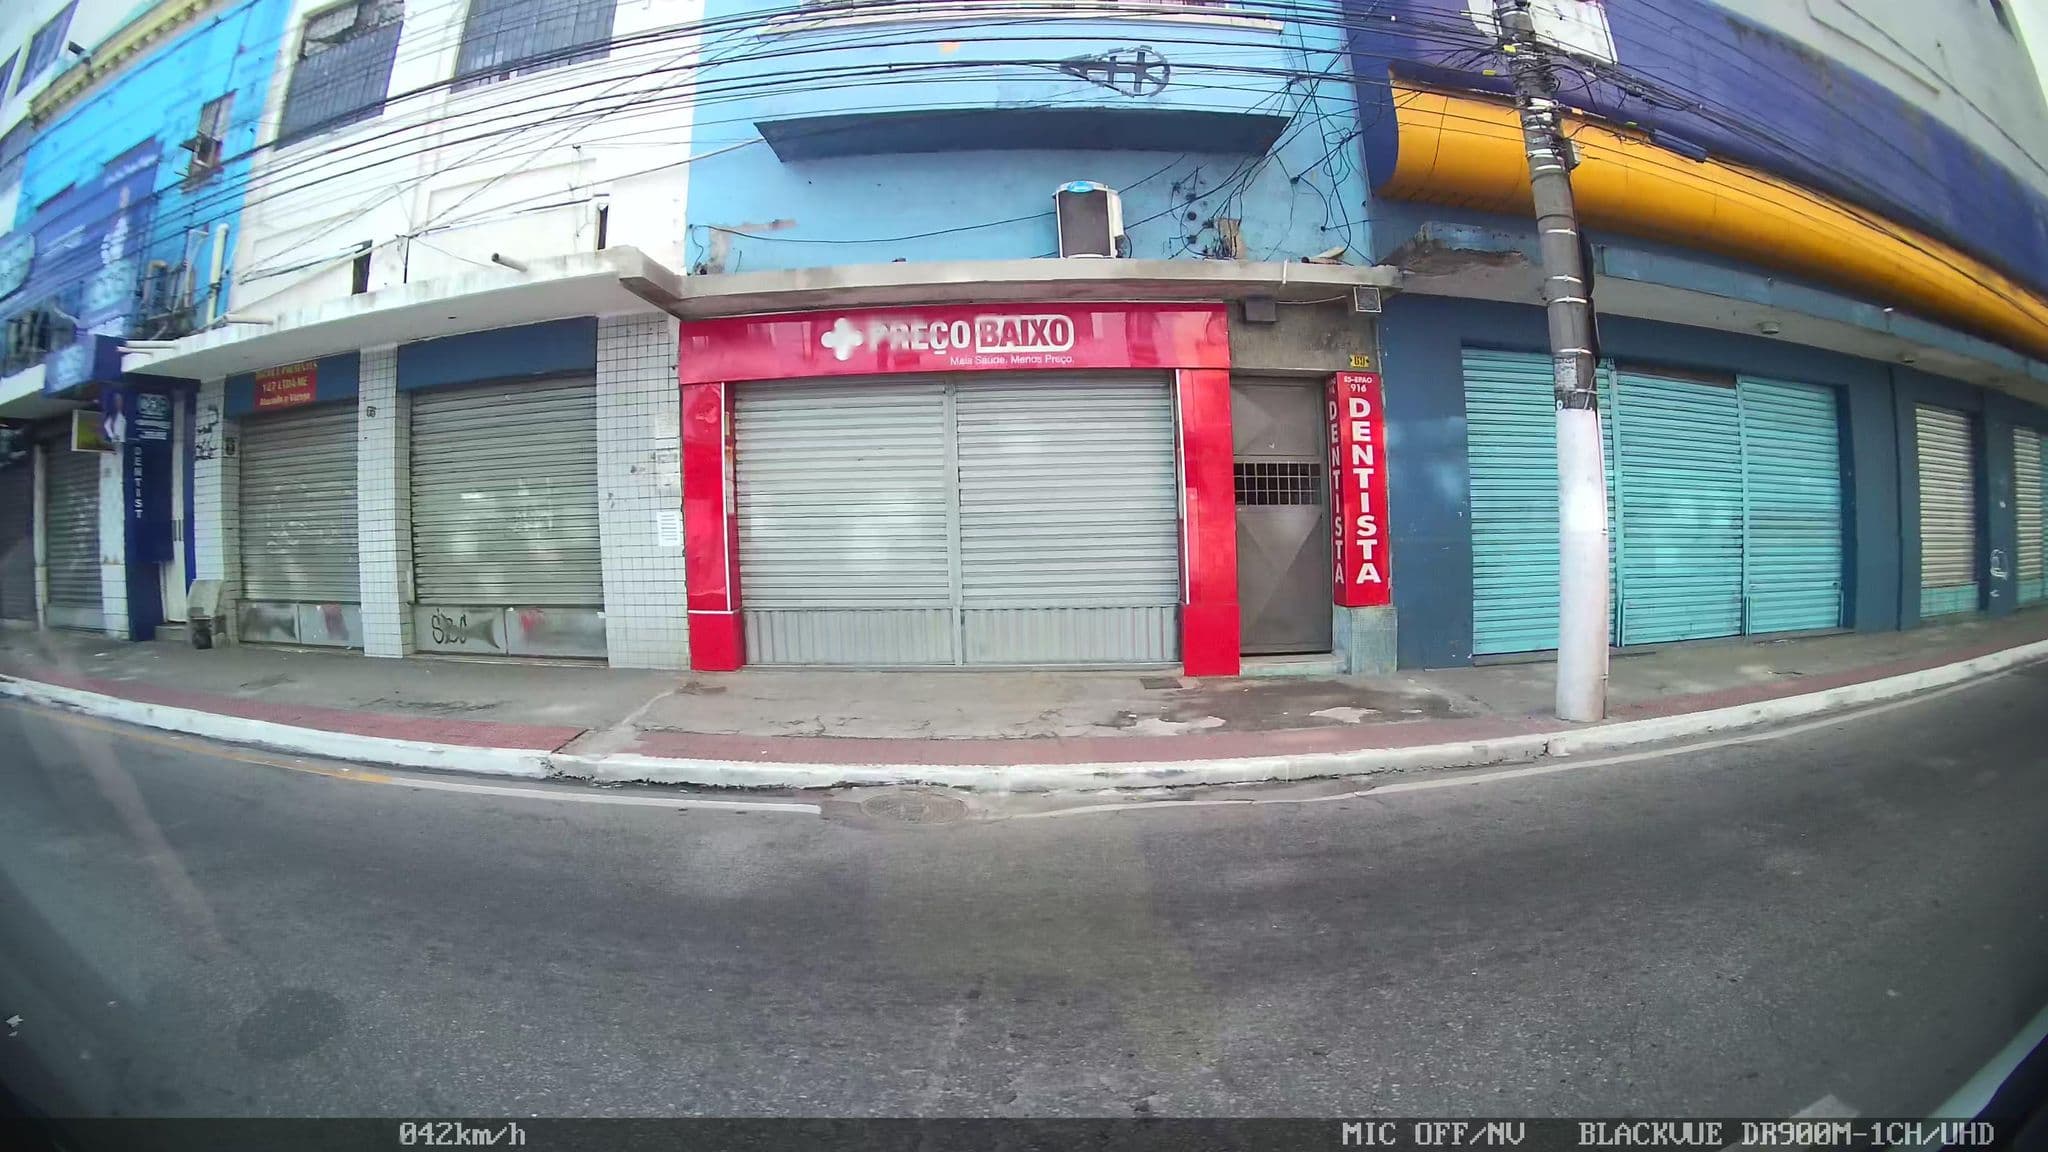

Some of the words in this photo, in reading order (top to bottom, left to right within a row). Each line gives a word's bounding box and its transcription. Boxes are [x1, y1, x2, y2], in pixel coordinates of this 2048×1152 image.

[869, 317, 971, 354] PREÇO
[979, 317, 1070, 347] BAIXO
[1350, 383, 1367, 393] 916
[1328, 401, 1345, 584] DENTISTA
[1348, 397, 1382, 585] DENTISTA
